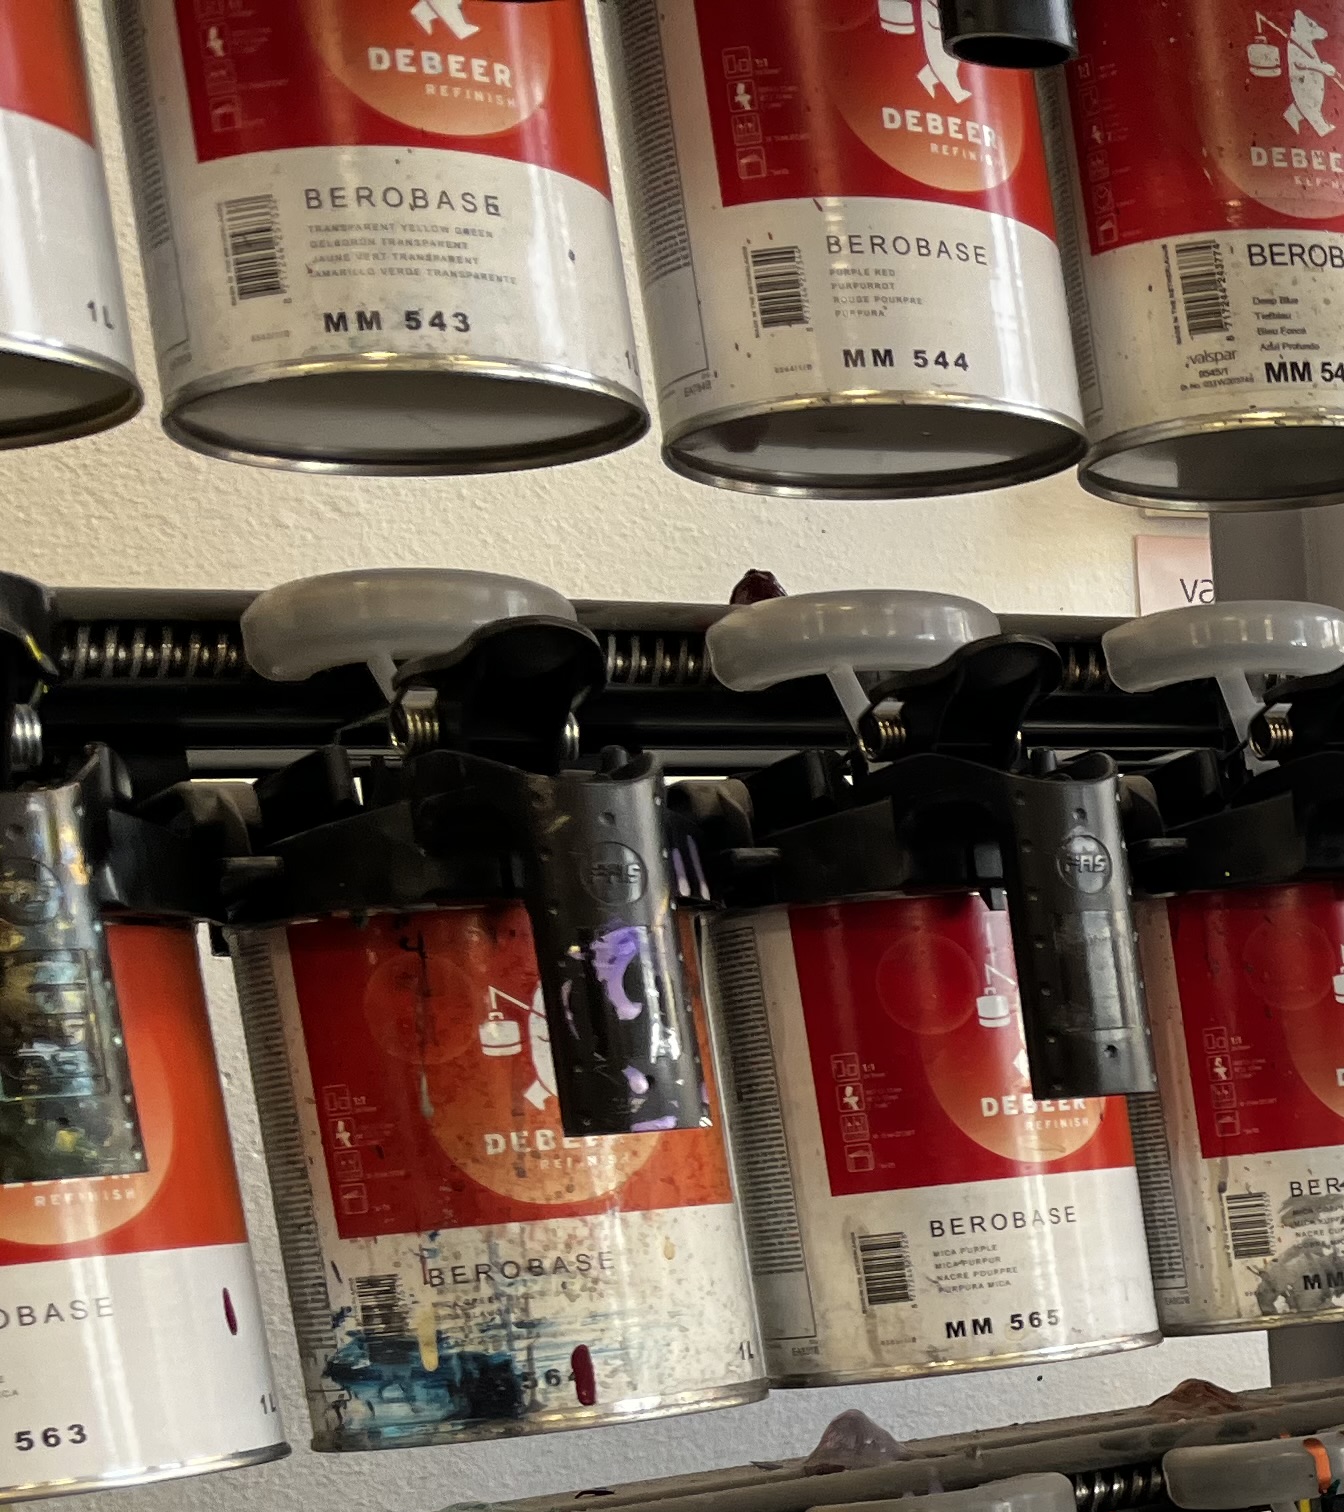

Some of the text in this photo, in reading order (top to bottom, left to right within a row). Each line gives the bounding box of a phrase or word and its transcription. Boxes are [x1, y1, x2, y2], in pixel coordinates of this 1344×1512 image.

[367, 46, 513, 89] DEBEER
[881, 106, 998, 150] DEBEER
[304, 186, 501, 216] BEROBASE
[826, 234, 988, 266] BEROBASE
[323, 309, 471, 333] MM 543
[843, 348, 969, 373] MM 544
[1188, 350, 1238, 367] valspar
[1264, 360, 1312, 384] MM
[34, 1187, 136, 1208] REFINISH
[930, 1205, 1078, 1238] BEROBASE
[427, 1250, 617, 1289] BEROBASE
[945, 1309, 1061, 1339] MM 565
[15, 1423, 88, 1453] 563
